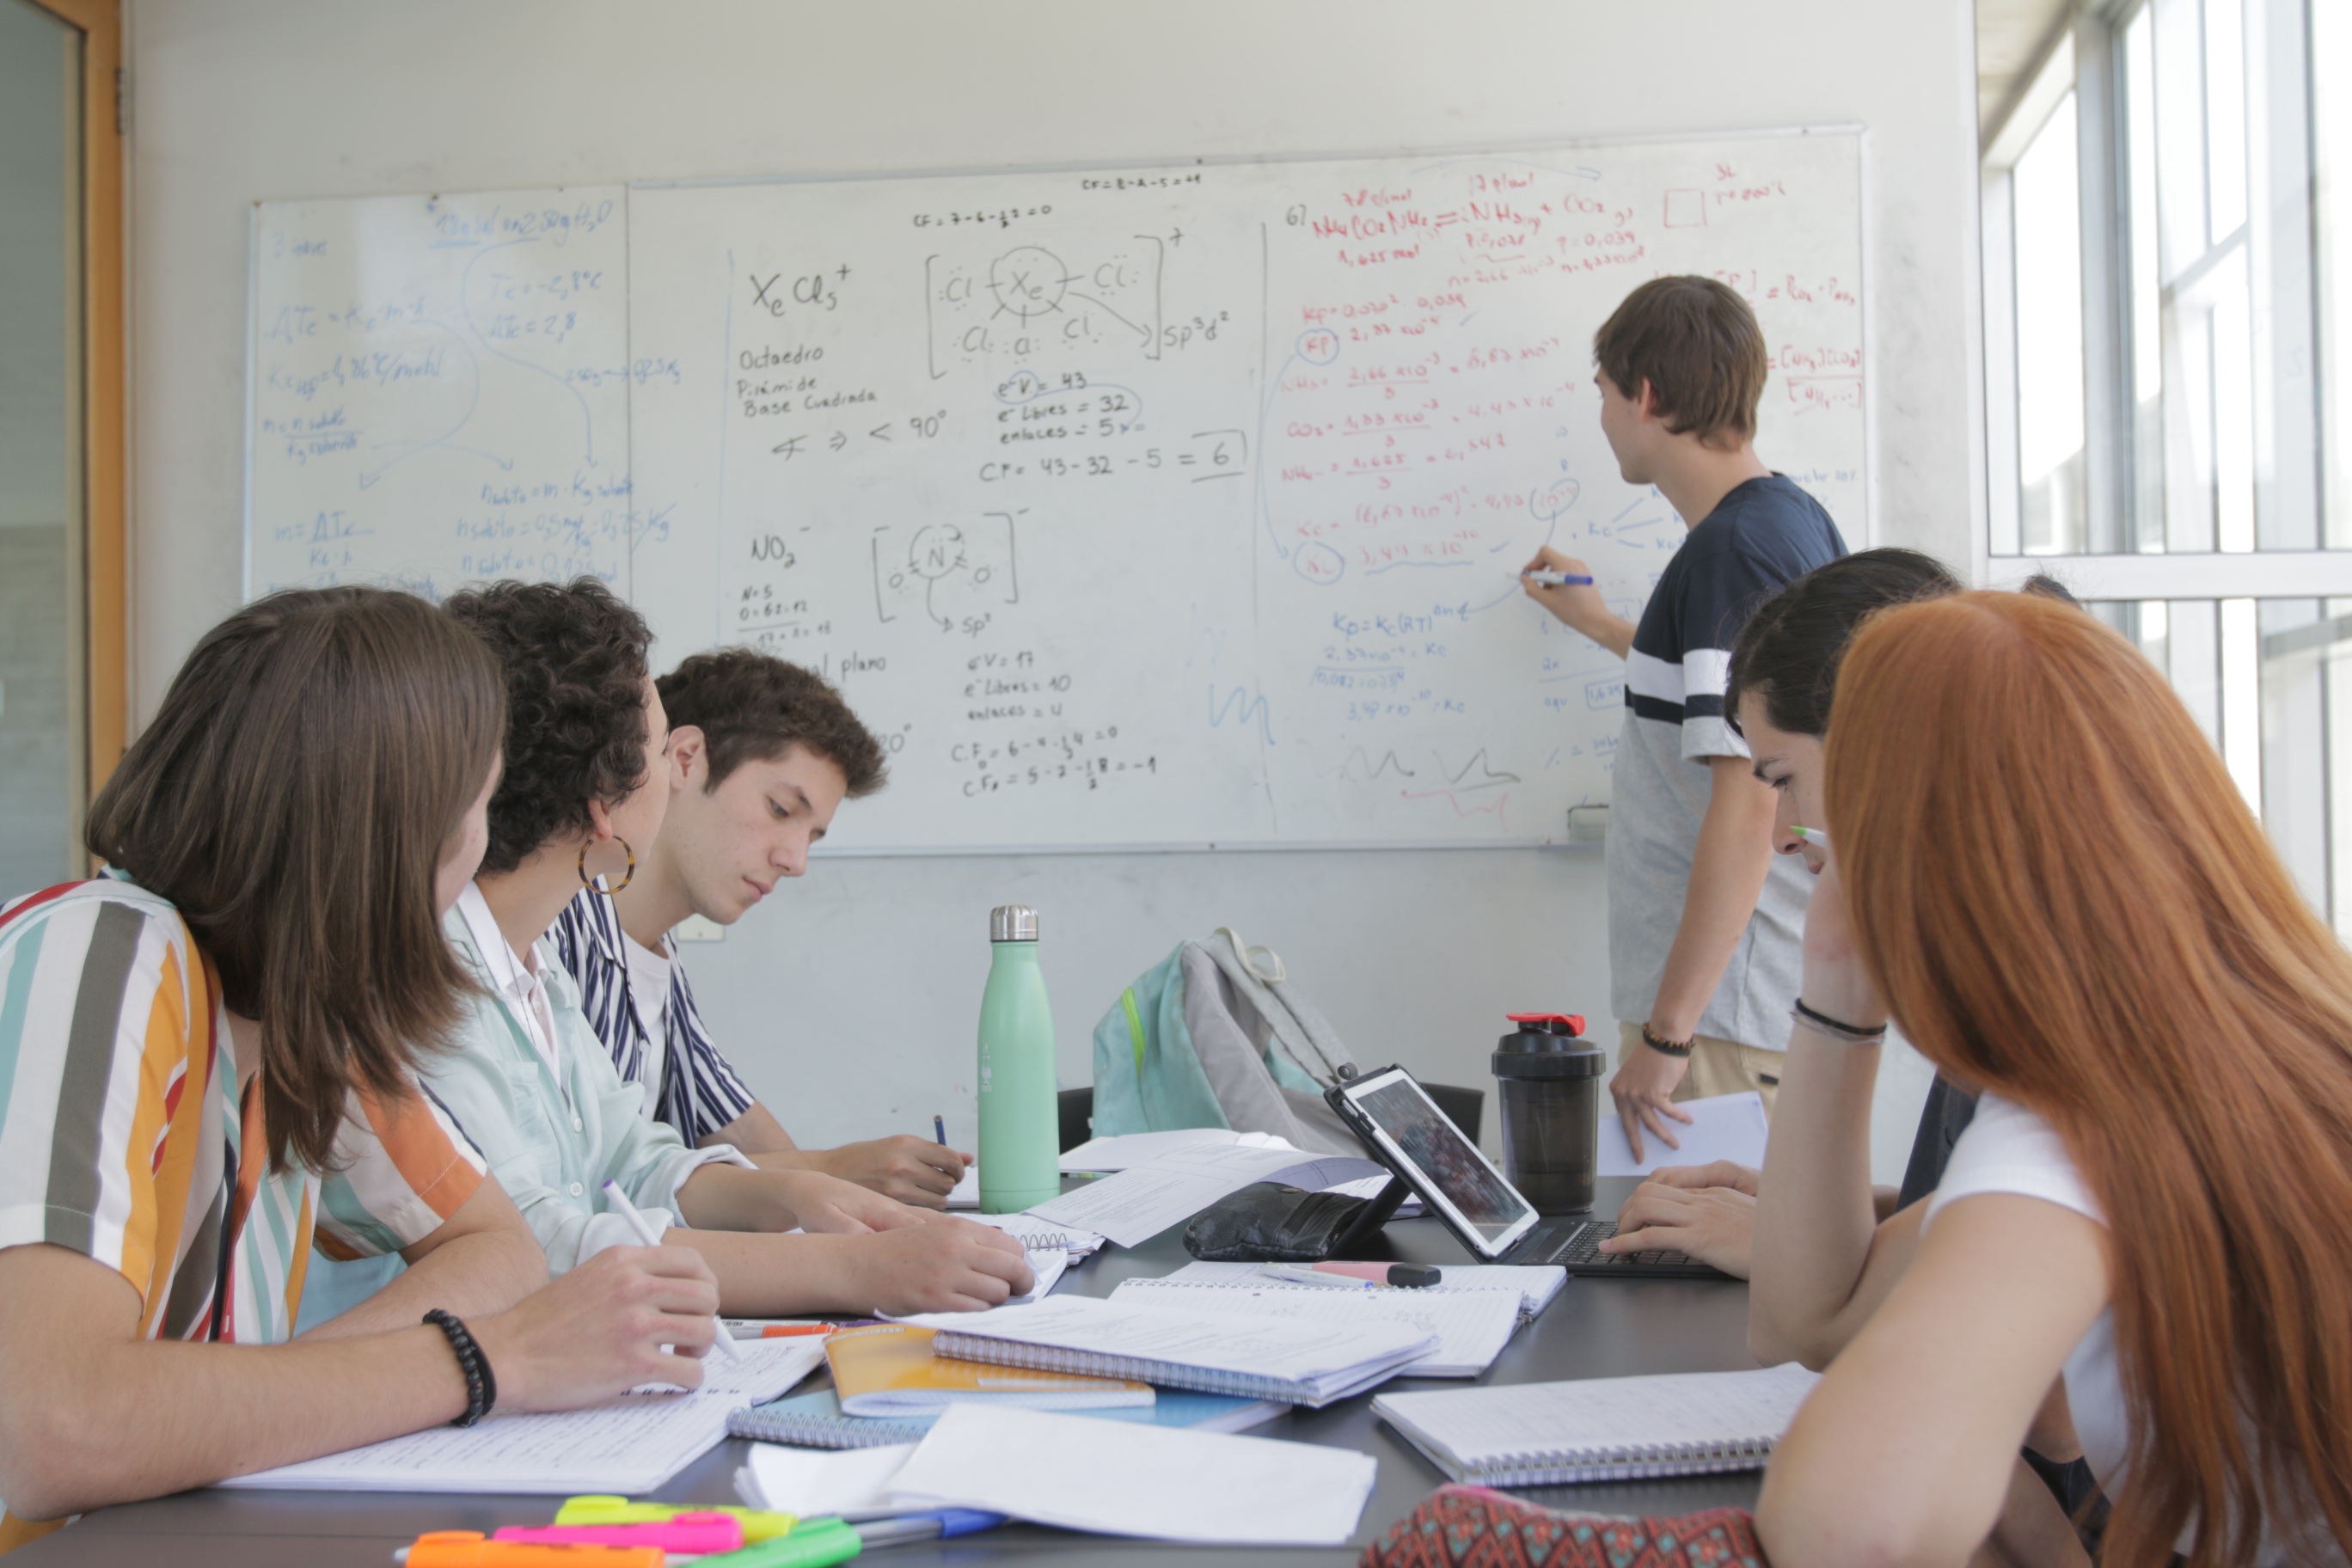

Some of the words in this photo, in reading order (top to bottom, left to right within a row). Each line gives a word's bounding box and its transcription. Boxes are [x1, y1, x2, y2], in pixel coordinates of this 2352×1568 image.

[739, 344, 824, 371] Octaedro
[744, 398, 793, 418] Base
[1099, 395, 1130, 413] 32
